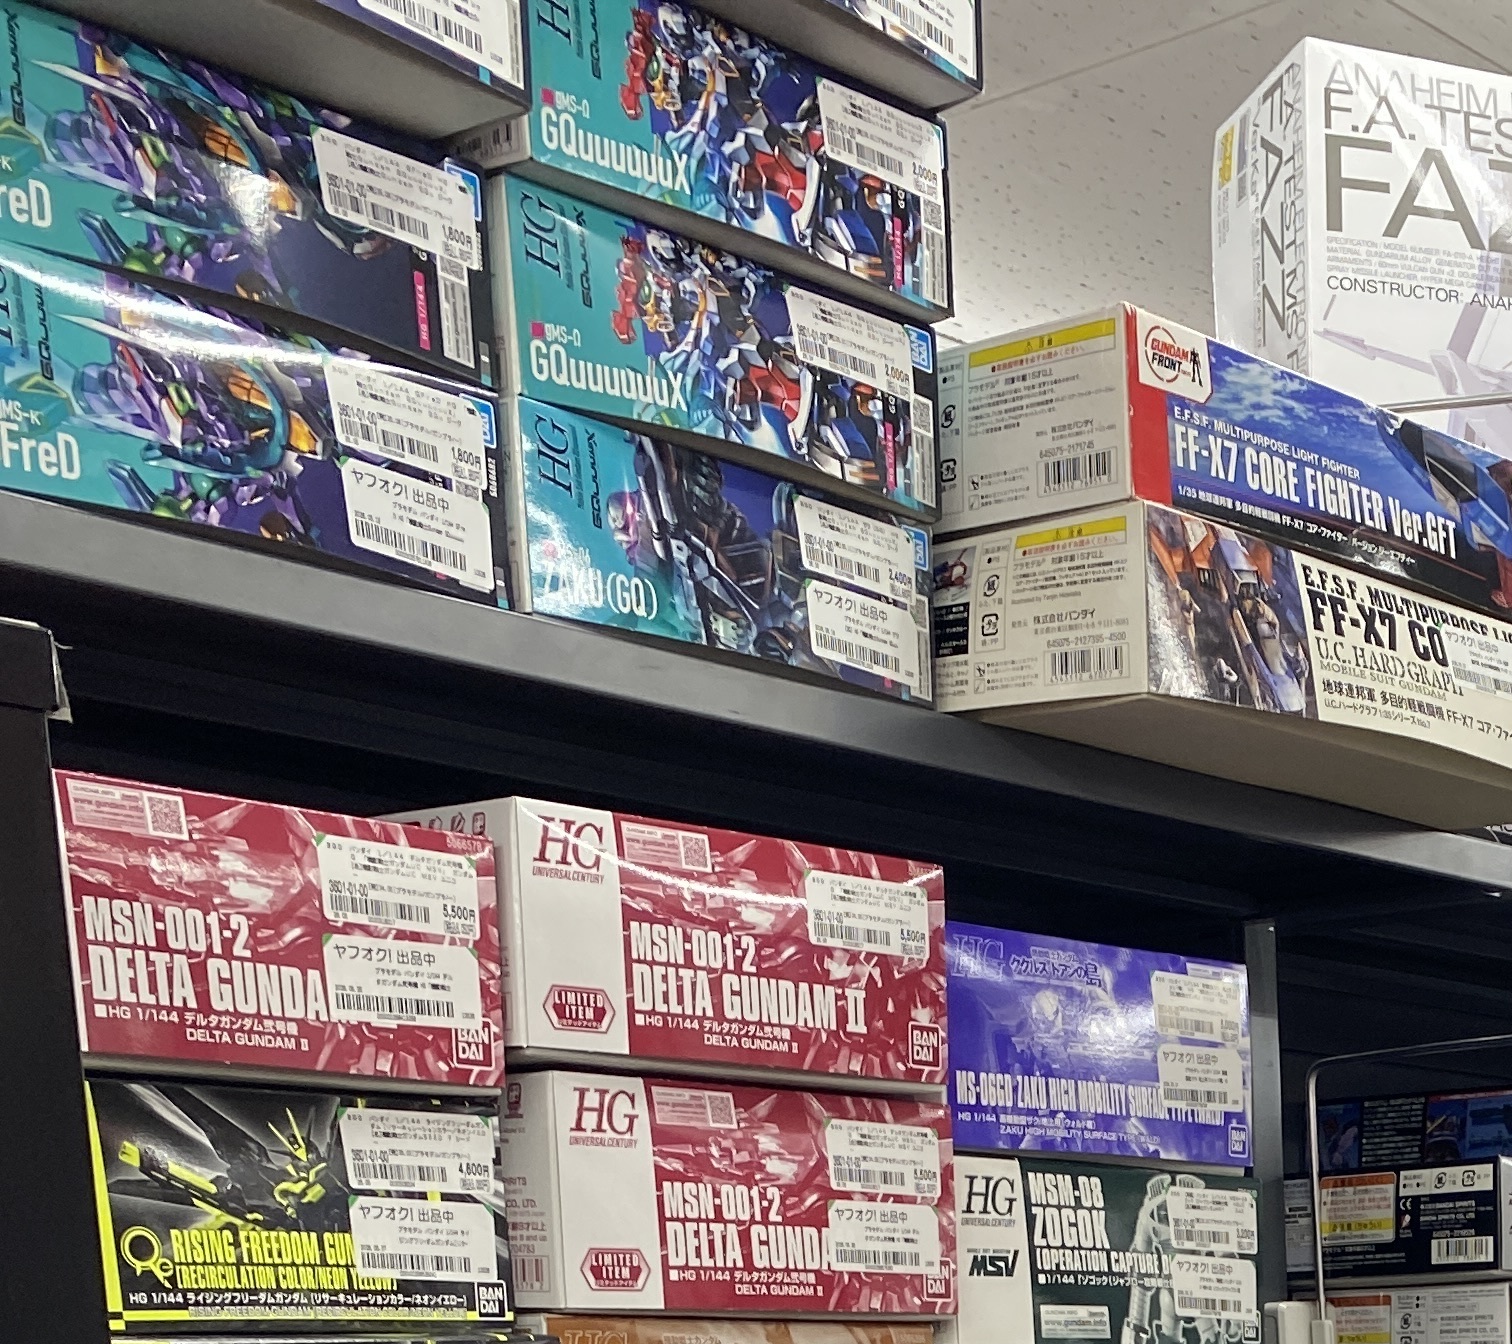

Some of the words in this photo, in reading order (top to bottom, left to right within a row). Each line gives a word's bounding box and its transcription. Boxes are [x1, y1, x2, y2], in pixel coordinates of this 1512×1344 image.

[1325, 60, 1498, 118] ANAHEIM
[441, 224, 473, 250] 1,800円
[1327, 276, 1466, 305] CONSTRUCTOR:
[1151, 337, 1190, 363] GUNDAM
[1151, 356, 1184, 375] FRONT
[2, 432, 81, 480] FreD
[1174, 406, 1212, 430] E.F.S.F.
[1214, 421, 1290, 454] MULTIPURPOSE
[1291, 448, 1319, 466] LIGHT
[1321, 456, 1360, 480] FIGHTER
[1175, 424, 1238, 483] FF-X7
[1245, 447, 1300, 503] CORE
[1306, 467, 1387, 532] FIGHTER
[1389, 500, 1456, 560] Ver.GFT
[1306, 588, 1396, 651] FF-X7
[1446, 710, 1473, 729] FF-X7
[534, 817, 607, 871] HG
[82, 896, 252, 958] MSN-001-2
[442, 903, 475, 921] 5,500円
[631, 923, 757, 973] MSN-001-2
[87, 943, 196, 1006] DELTA
[554, 991, 603, 1008] LIMITED
[565, 1006, 594, 1020] ITEM
[632, 964, 712, 1016] DELTA
[724, 975, 837, 1030] GUNDAM
[137, 1009, 179, 1023] 1/144
[459, 1162, 488, 1177] 4,600円
[1028, 1172, 1105, 1207] MSM-08
[1032, 1207, 1110, 1249] ZOGOK
[171, 1229, 238, 1263] RISING
[242, 1231, 318, 1266] FREEDOM
[276, 1266, 350, 1290] COLOR/NEON
[187, 1292, 307, 1305] ライジングフリーダムガンダム
